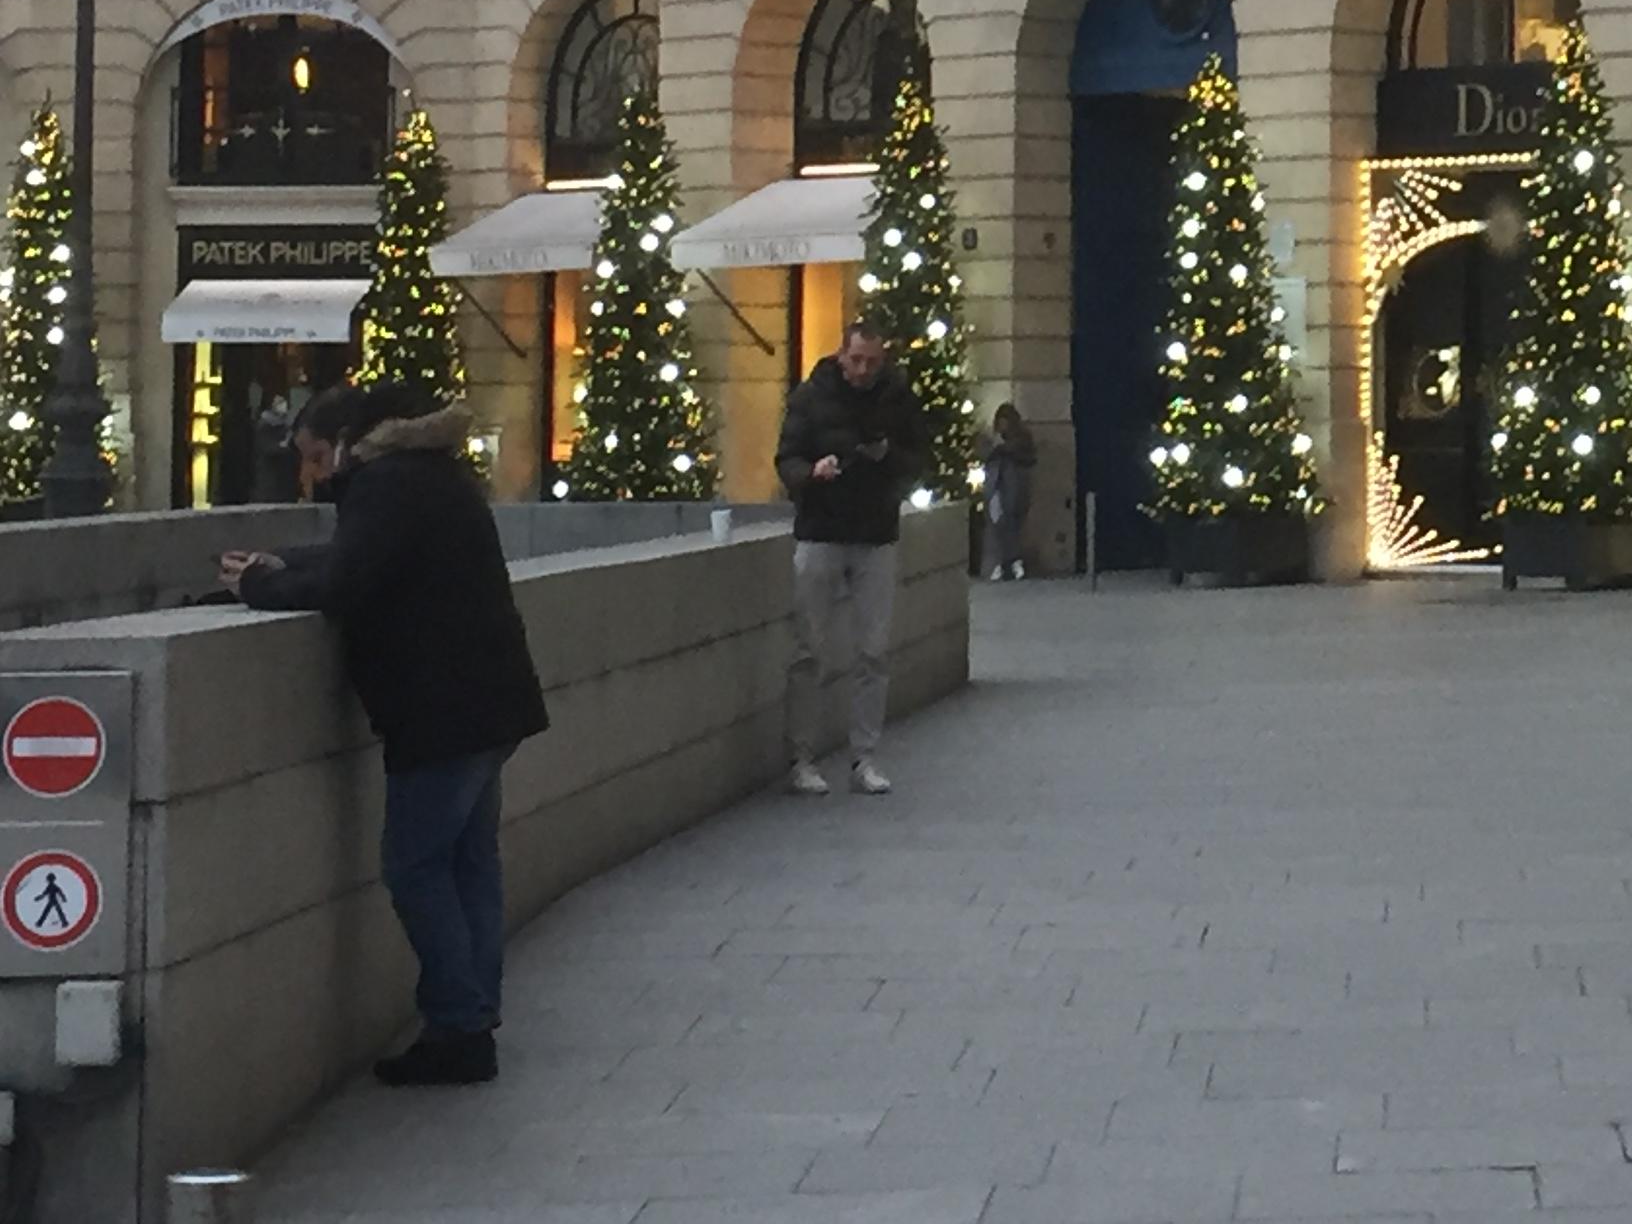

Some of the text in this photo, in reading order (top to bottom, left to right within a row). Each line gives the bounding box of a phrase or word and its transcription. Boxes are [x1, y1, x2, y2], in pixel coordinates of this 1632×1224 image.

[1454, 83, 1544, 137] Dior
[192, 240, 372, 265] PATEK PHILIPPE
